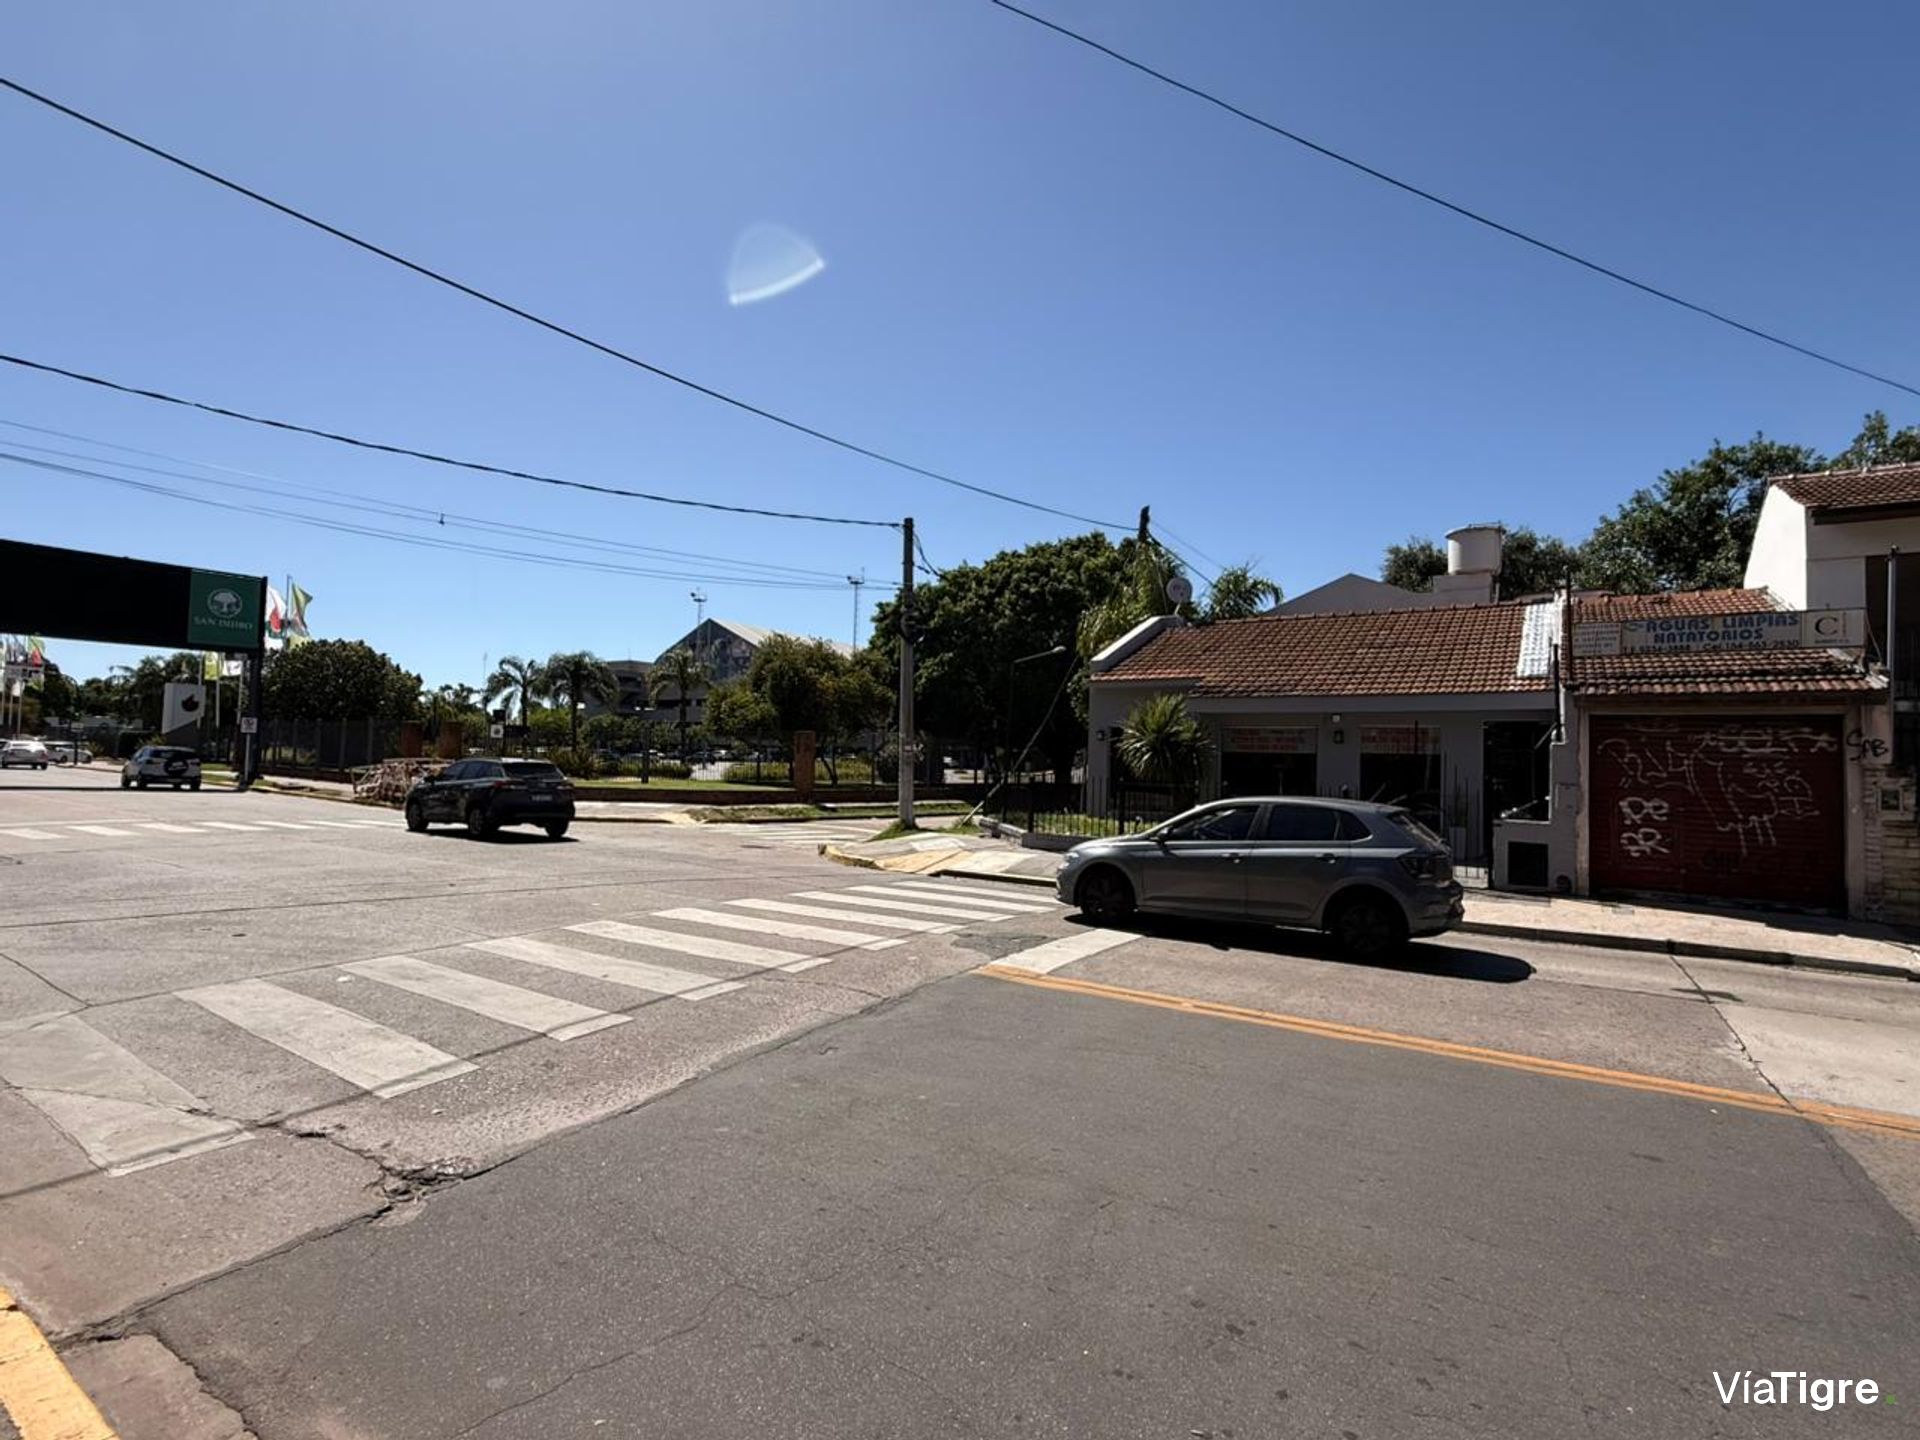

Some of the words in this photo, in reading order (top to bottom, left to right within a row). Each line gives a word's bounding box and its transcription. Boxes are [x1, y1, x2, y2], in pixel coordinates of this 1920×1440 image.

[1646, 618, 1711, 634] AGUAS
[1722, 613, 1799, 630] LIMPIAS
[1654, 628, 1764, 645] NATATORIOS
